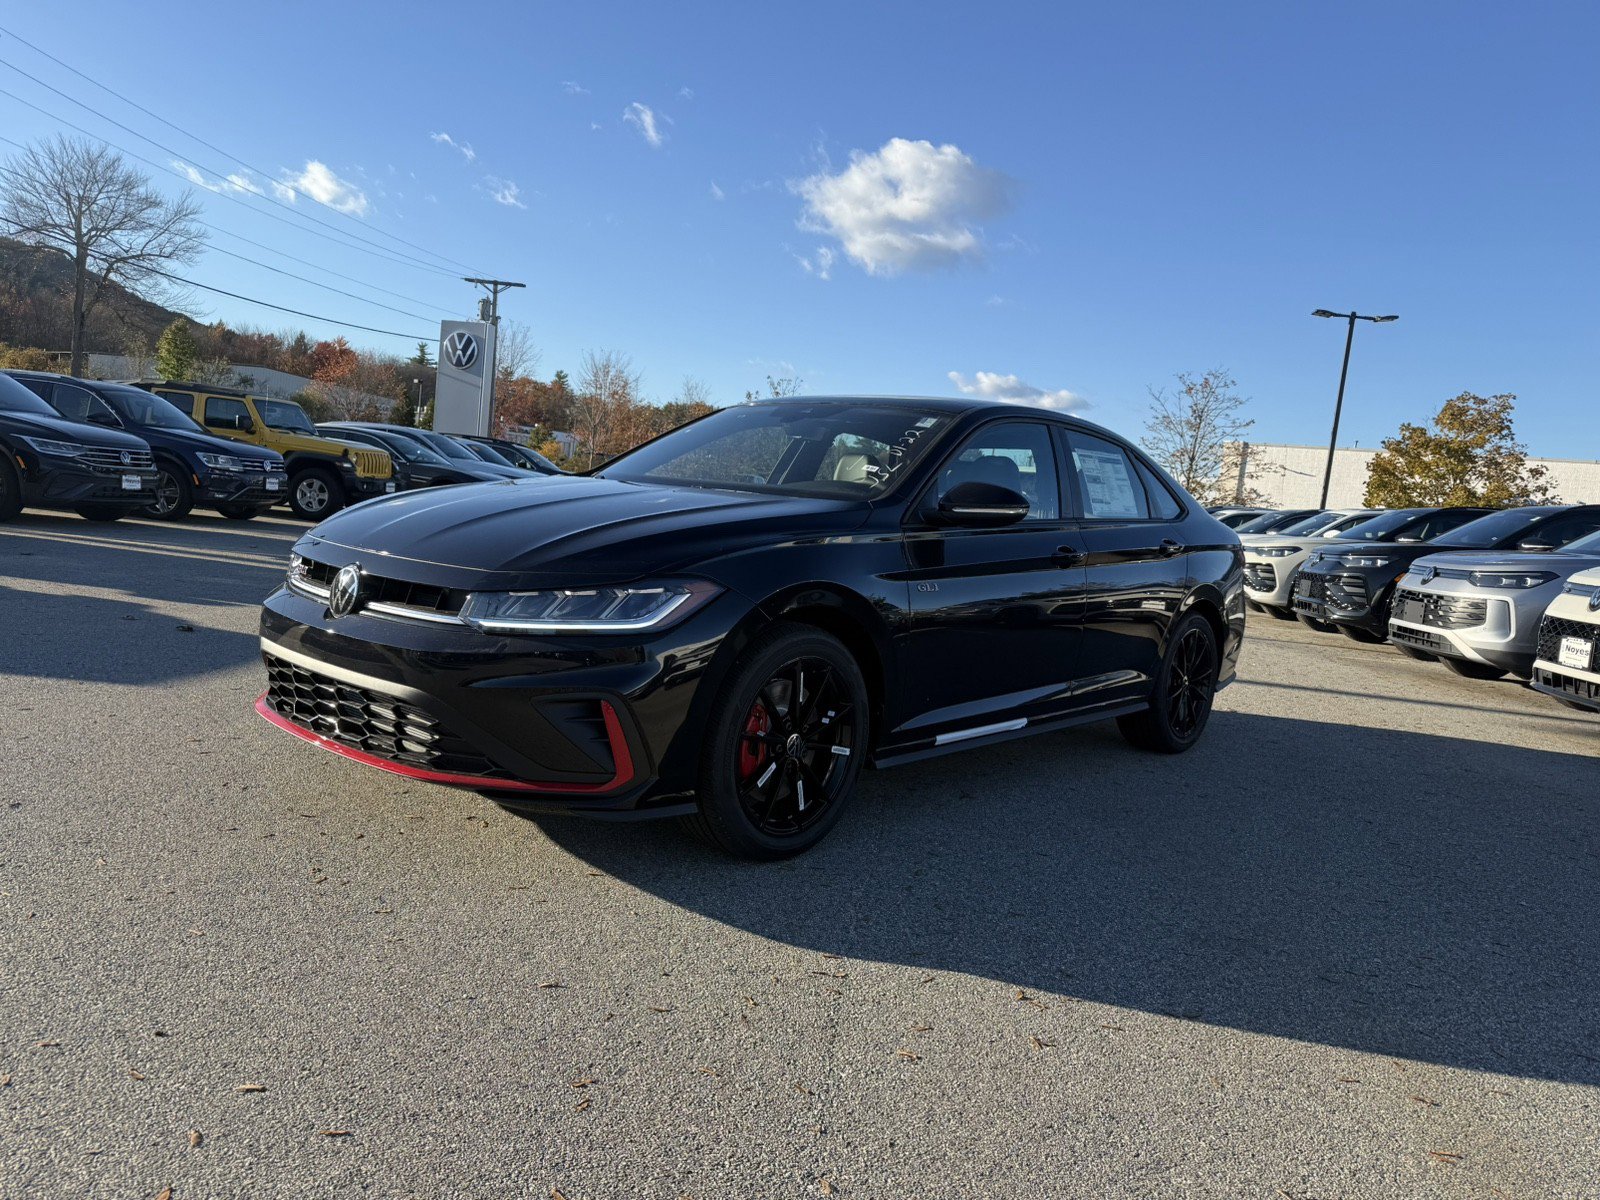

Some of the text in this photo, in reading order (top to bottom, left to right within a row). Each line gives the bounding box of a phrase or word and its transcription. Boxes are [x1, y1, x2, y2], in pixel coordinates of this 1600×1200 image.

[443, 330, 478, 370] VW
[329, 566, 359, 619] VW
[917, 582, 940, 592] GLI
[1565, 644, 1590, 657] Noyes
